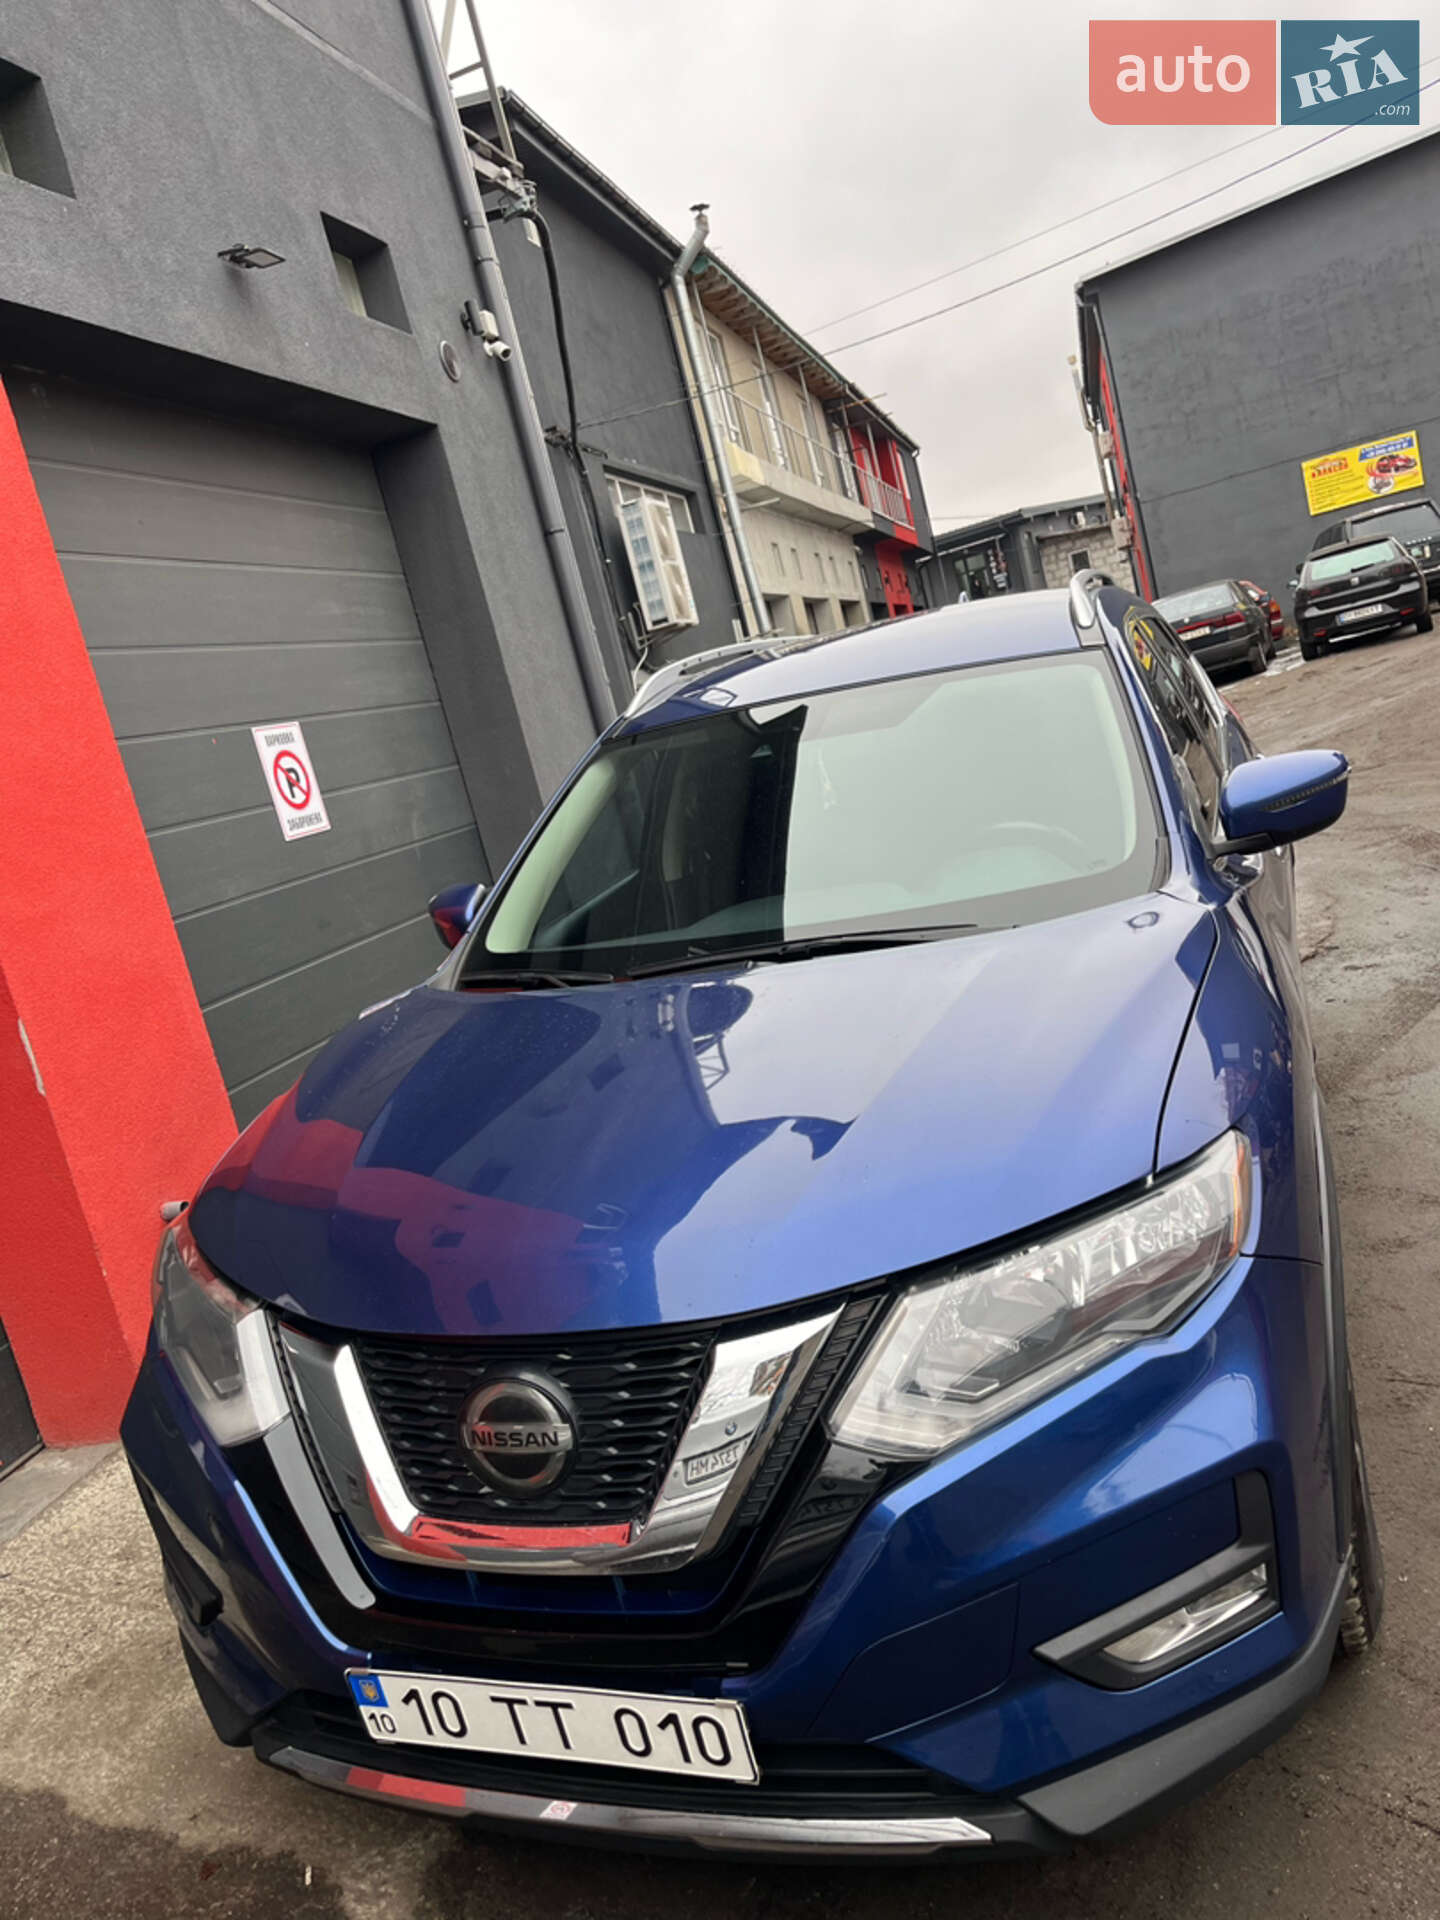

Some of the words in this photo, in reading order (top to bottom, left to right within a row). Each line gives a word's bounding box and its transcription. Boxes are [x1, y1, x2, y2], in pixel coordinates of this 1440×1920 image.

[470, 1430, 560, 1449] NISSAN
[368, 1712, 397, 1734] 10
[401, 1688, 469, 1740] 10
[490, 1695, 574, 1750] TT
[614, 1707, 732, 1767] 010
